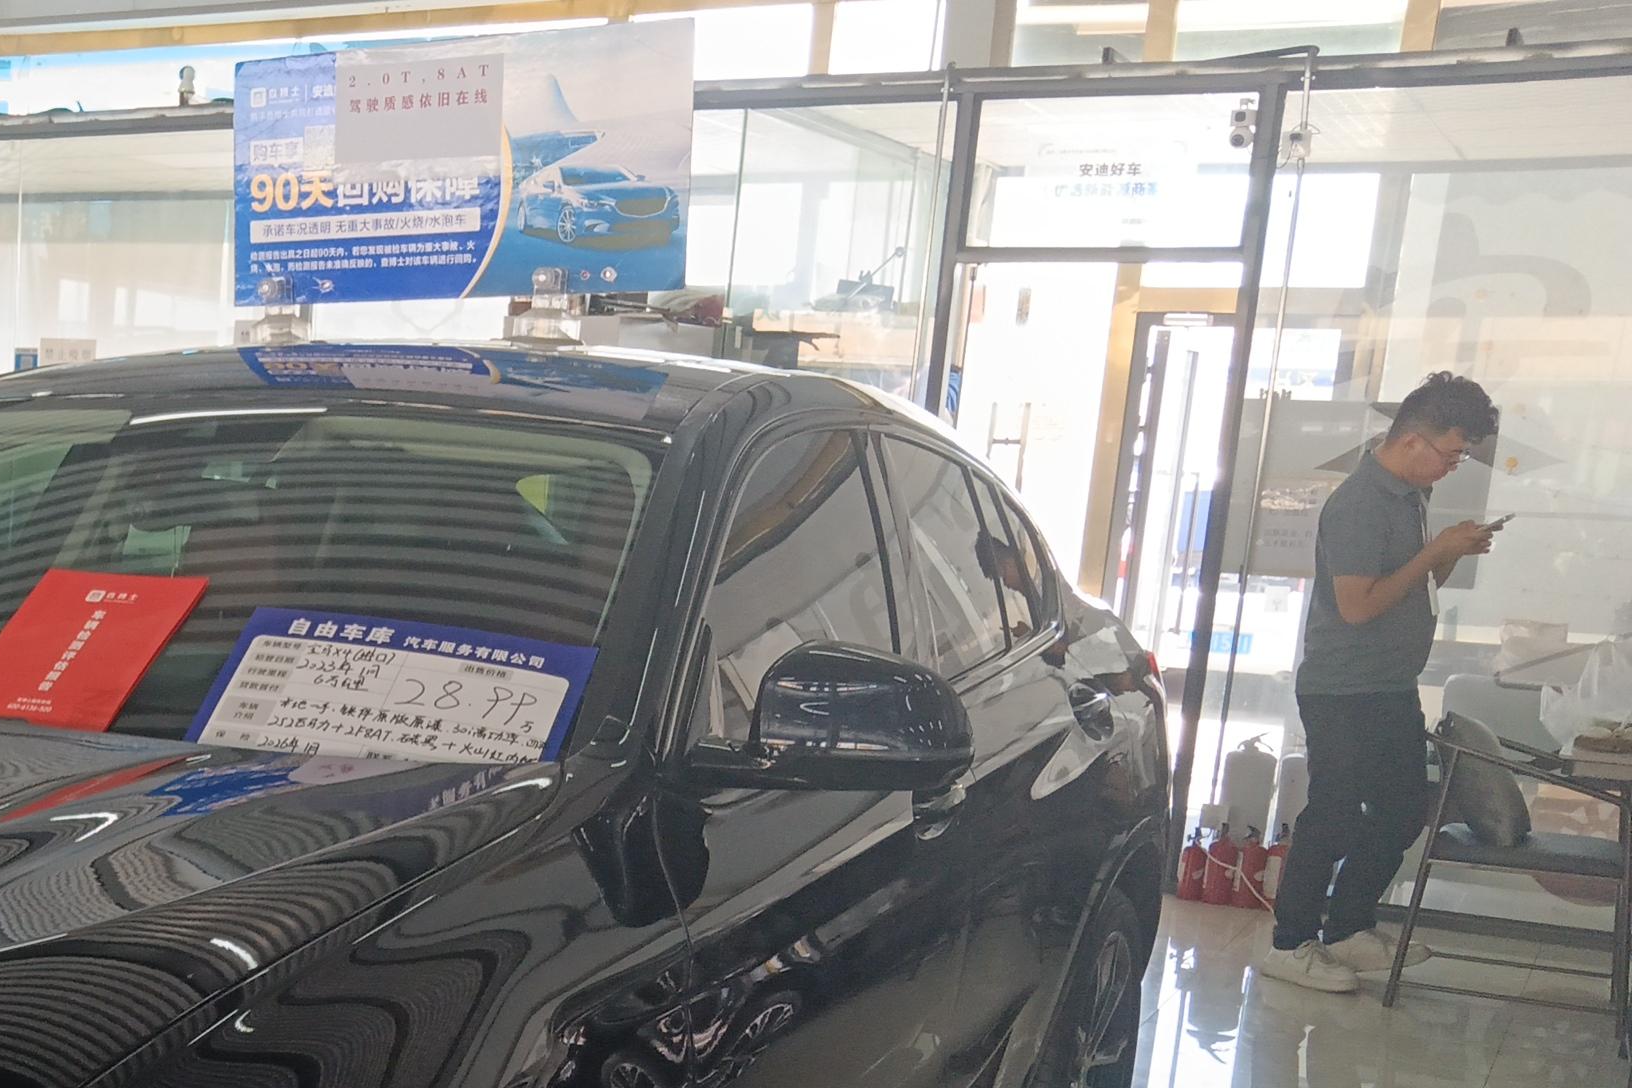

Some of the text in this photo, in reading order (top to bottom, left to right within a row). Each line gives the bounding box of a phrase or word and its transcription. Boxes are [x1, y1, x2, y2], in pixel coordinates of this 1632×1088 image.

[349, 88, 488, 114] 驾驶质感依旧在线
[1078, 162, 1142, 177] 安迪好车
[263, 213, 466, 238] 承诺车况透明 无重大事故/火烧/水泡车
[288, 617, 546, 669] 自由车库 汽车服务有限公司
